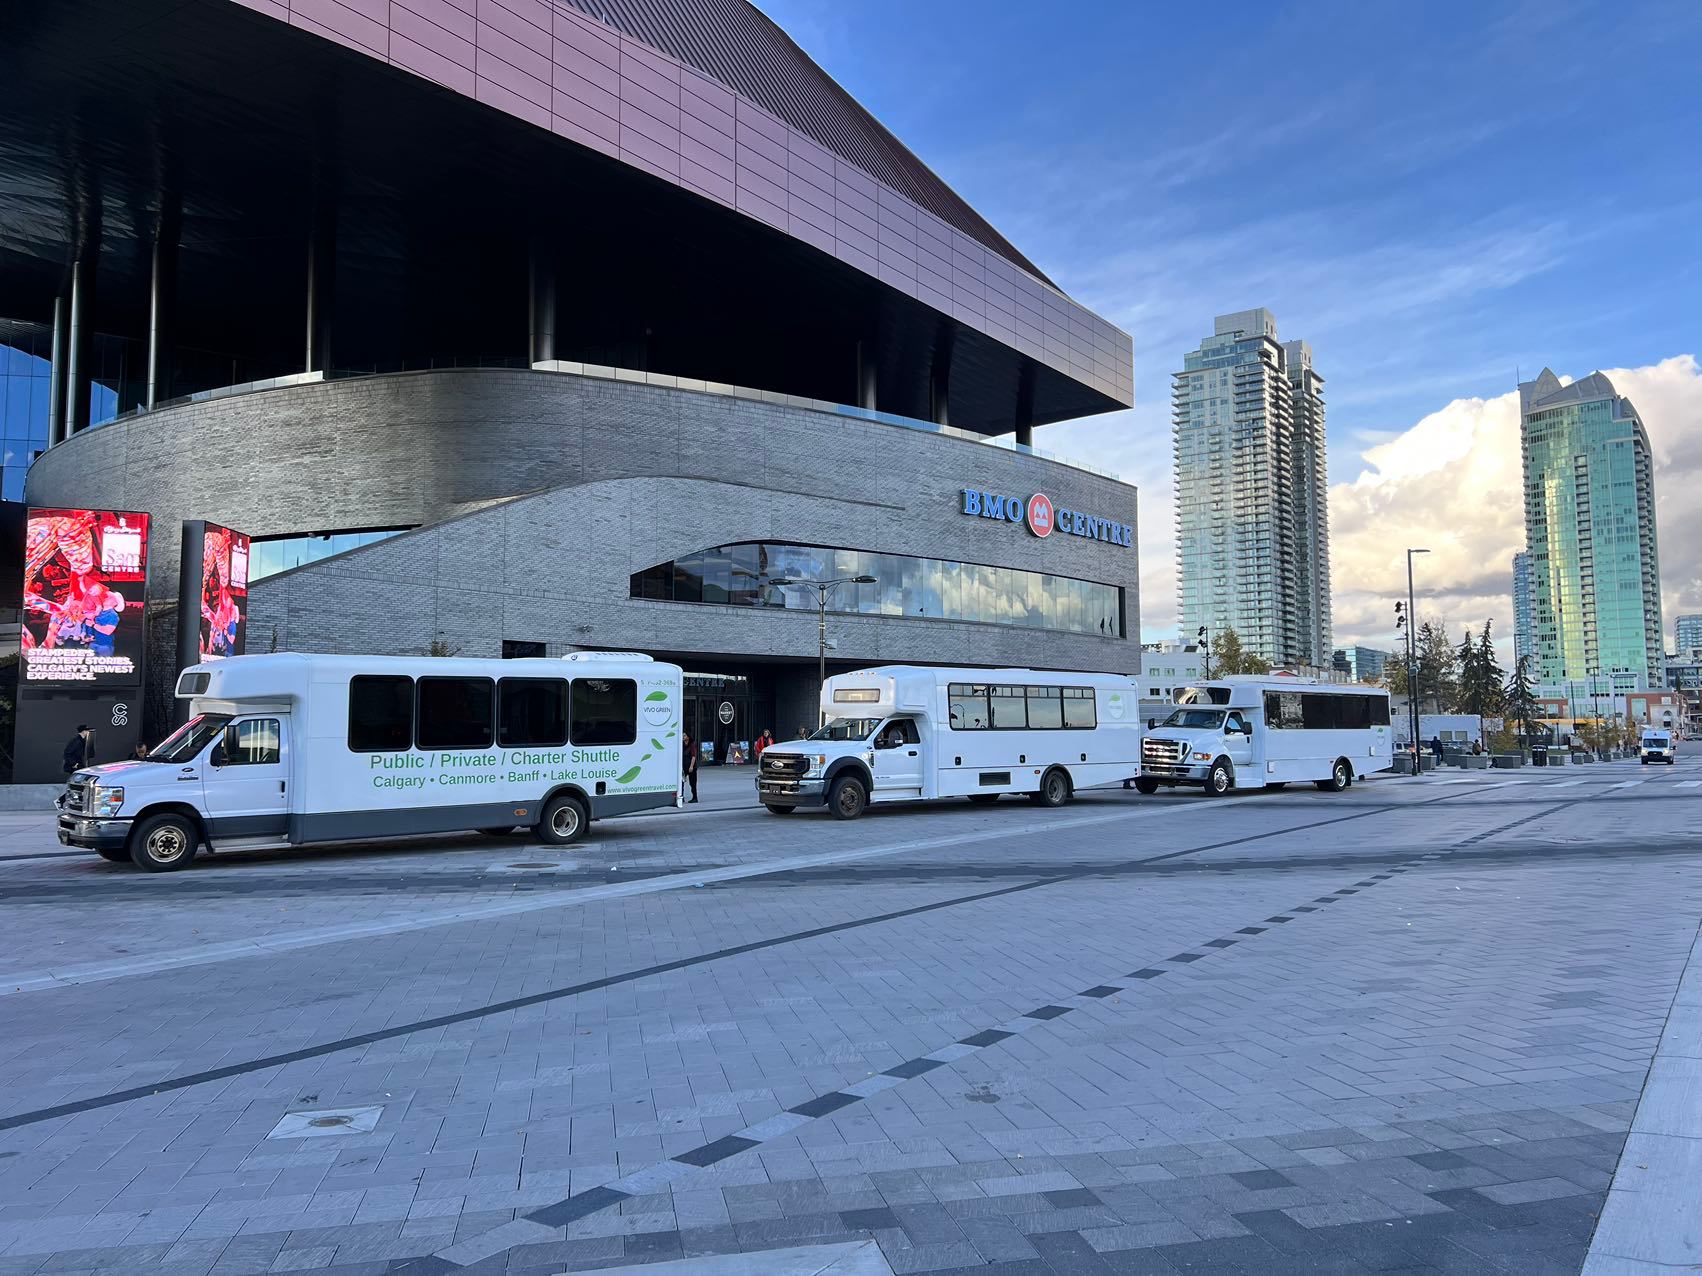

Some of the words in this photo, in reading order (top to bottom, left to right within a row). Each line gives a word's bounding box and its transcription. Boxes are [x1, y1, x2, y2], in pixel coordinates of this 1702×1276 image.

[962, 489, 1024, 523] BMO
[1056, 508, 1133, 547] CENTRE
[102, 565, 140, 573] CENTRE
[27, 648, 95, 657] STAMPEDE'S
[27, 656, 85, 664] GREATEST
[26, 664, 89, 673] CALGARY'S
[89, 665, 135, 673] NEWEST
[26, 672, 97, 680] EXPERIENCE.
[370, 753, 425, 770] Public
[440, 751, 497, 768] Private
[511, 750, 567, 766] Charter
[571, 749, 620, 764] Shuttle
[372, 774, 426, 790] Calgary
[438, 772, 497, 786] Canmore
[508, 770, 540, 783] Banff
[551, 769, 578, 781] Lake
[581, 768, 617, 779] Louise
[607, 784, 677, 794] www.vivogreentravel.com
